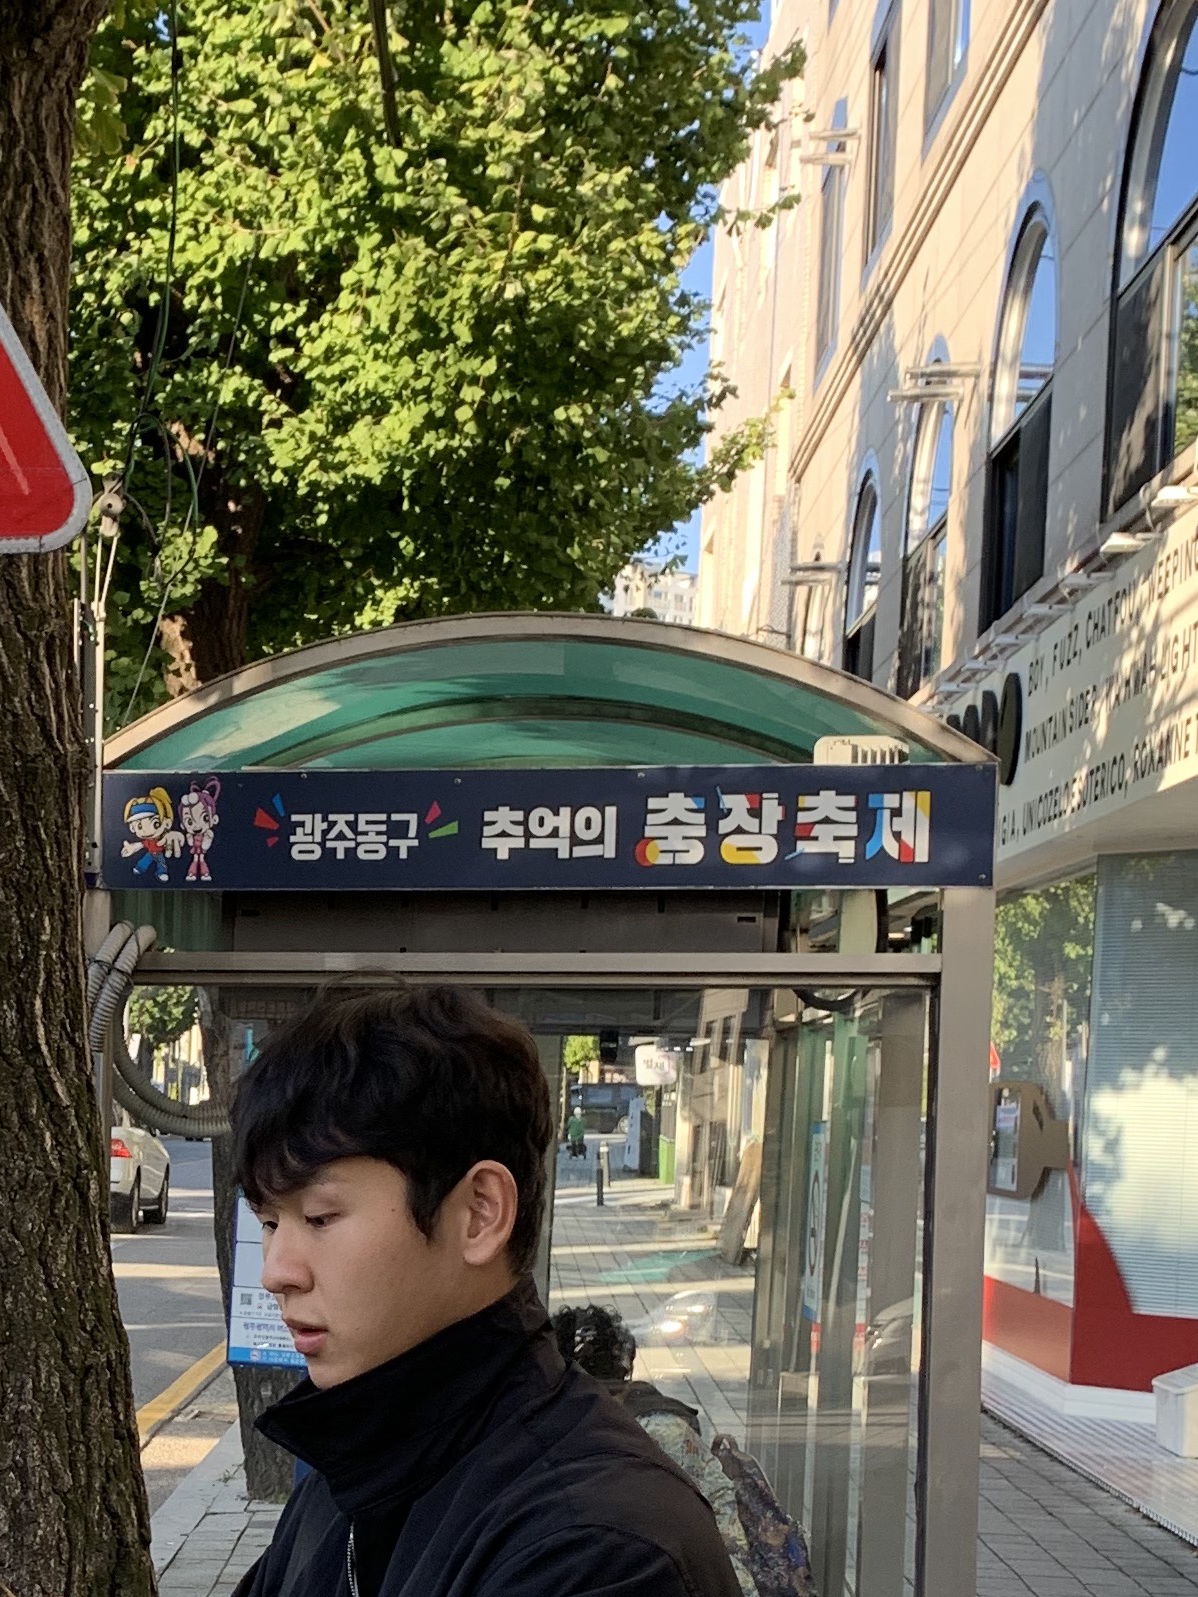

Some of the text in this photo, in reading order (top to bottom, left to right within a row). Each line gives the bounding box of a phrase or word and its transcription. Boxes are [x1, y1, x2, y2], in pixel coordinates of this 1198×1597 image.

[289, 790, 931, 865] 광주동구 추억의 충장축제
